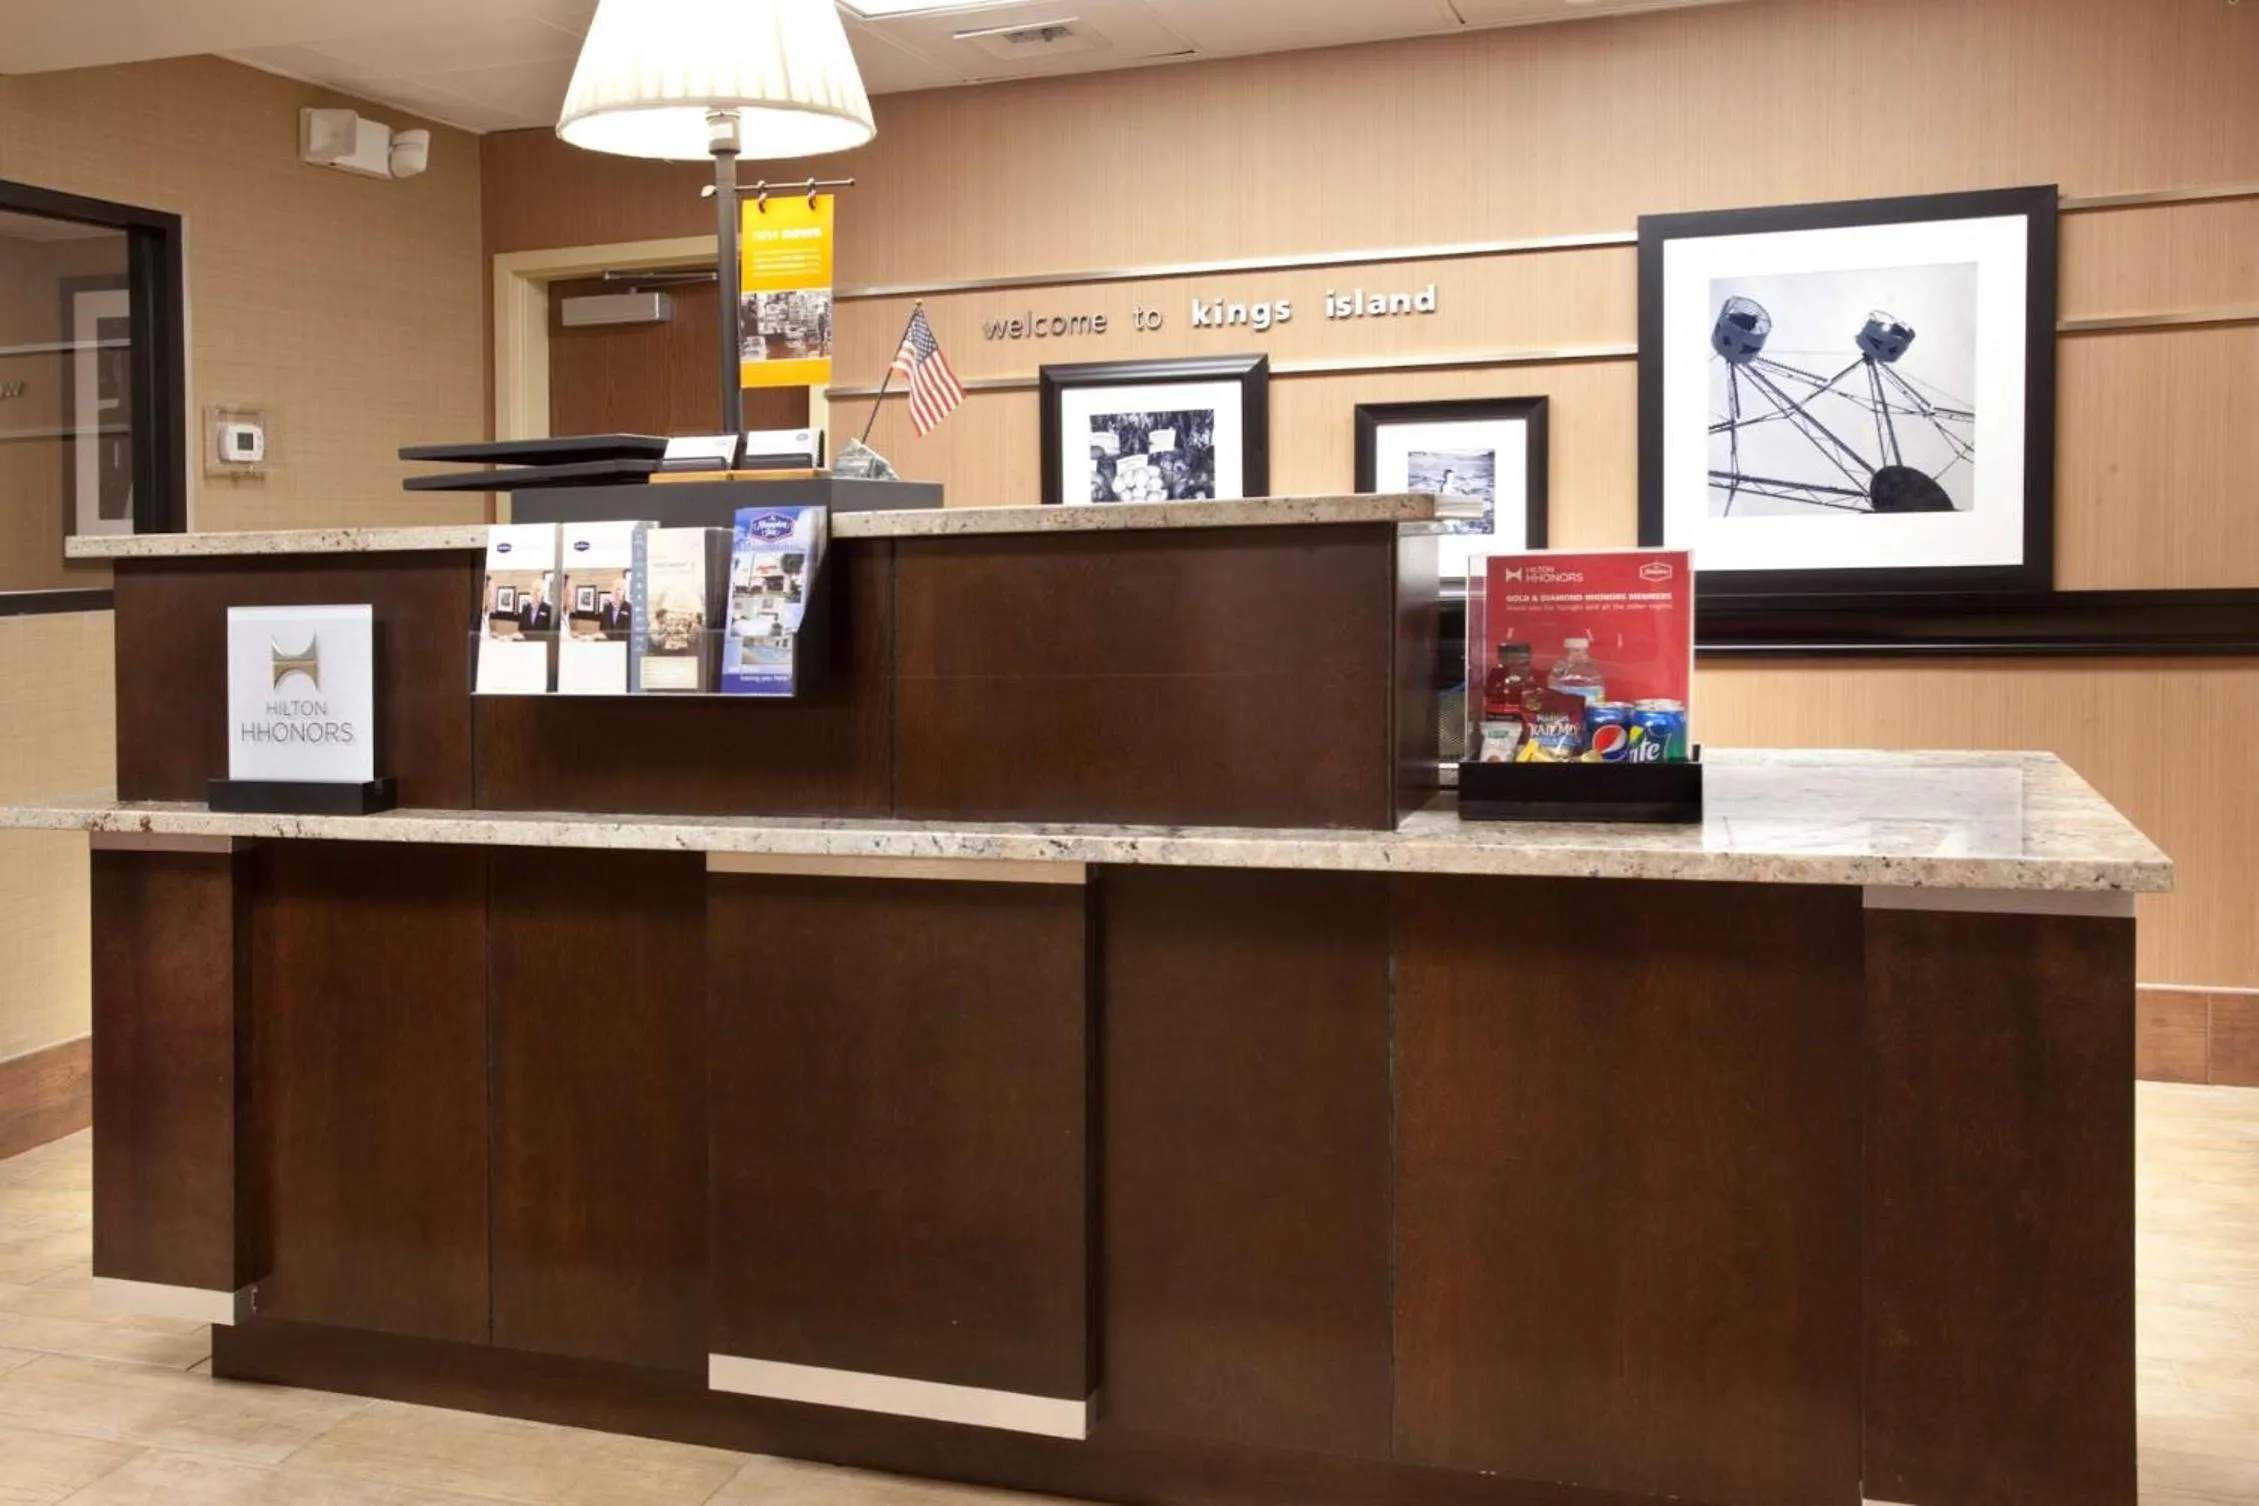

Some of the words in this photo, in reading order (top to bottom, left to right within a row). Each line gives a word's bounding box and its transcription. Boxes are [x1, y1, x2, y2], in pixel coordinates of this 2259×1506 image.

[982, 311, 1108, 341] welcome
[1132, 305, 1164, 332] to
[1191, 298, 1292, 334] kings
[1325, 284, 1437, 320] island
[1526, 572, 1584, 583] HHONORS
[266, 700, 327, 717] HILTON
[241, 722, 354, 743] HHONORS
